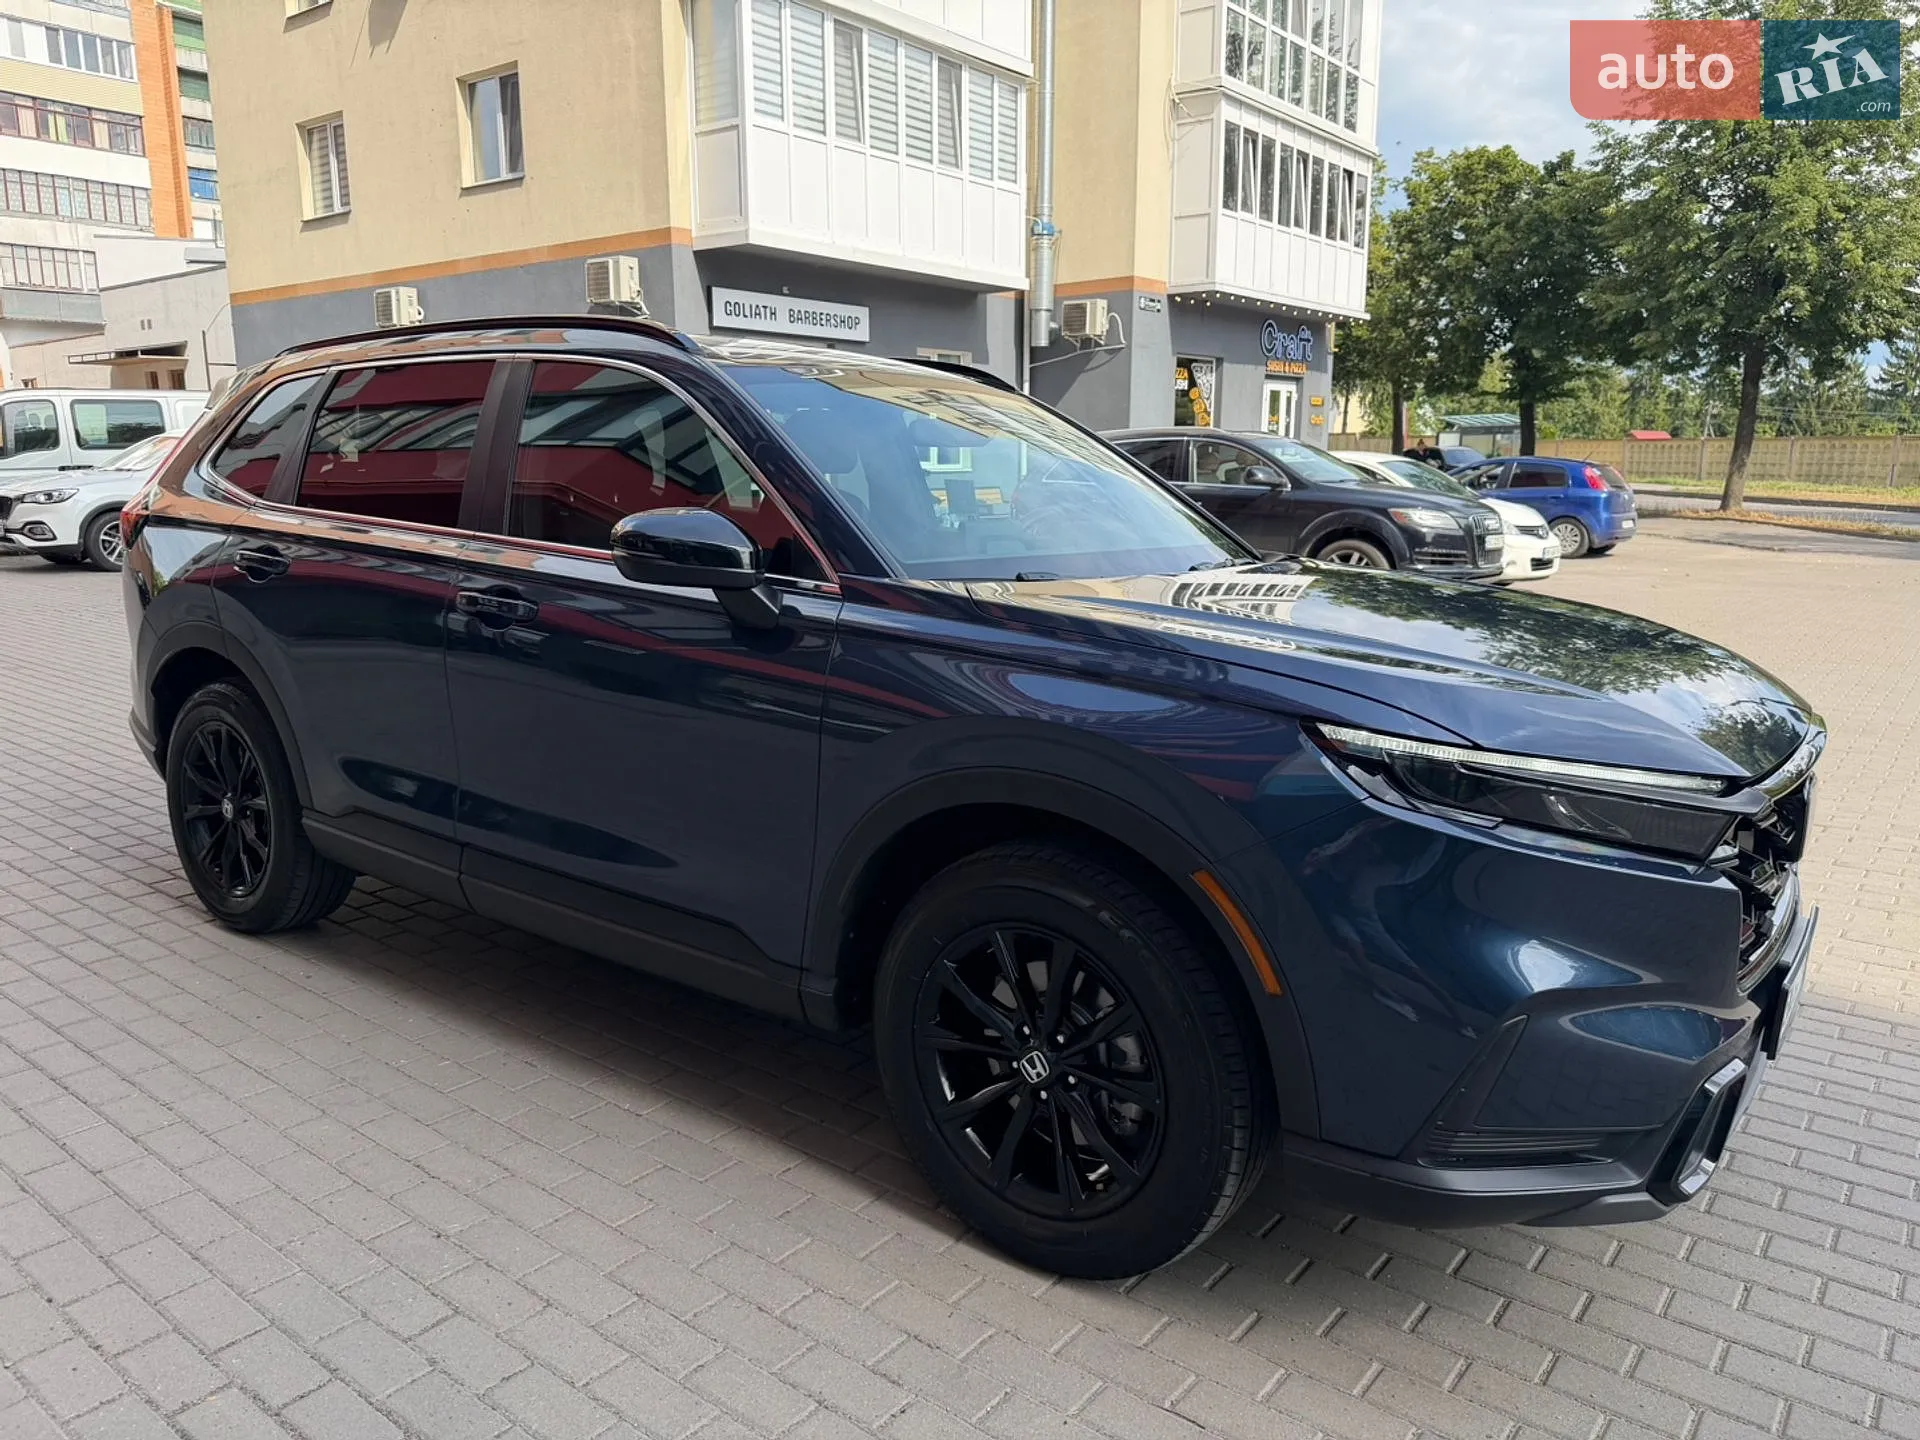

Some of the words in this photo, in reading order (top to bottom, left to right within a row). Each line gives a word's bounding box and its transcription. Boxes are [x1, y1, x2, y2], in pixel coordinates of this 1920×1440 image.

[724, 300, 777, 321] GOLIATH
[788, 308, 861, 330] BARBERSHOP
[1262, 319, 1312, 361] Craft
